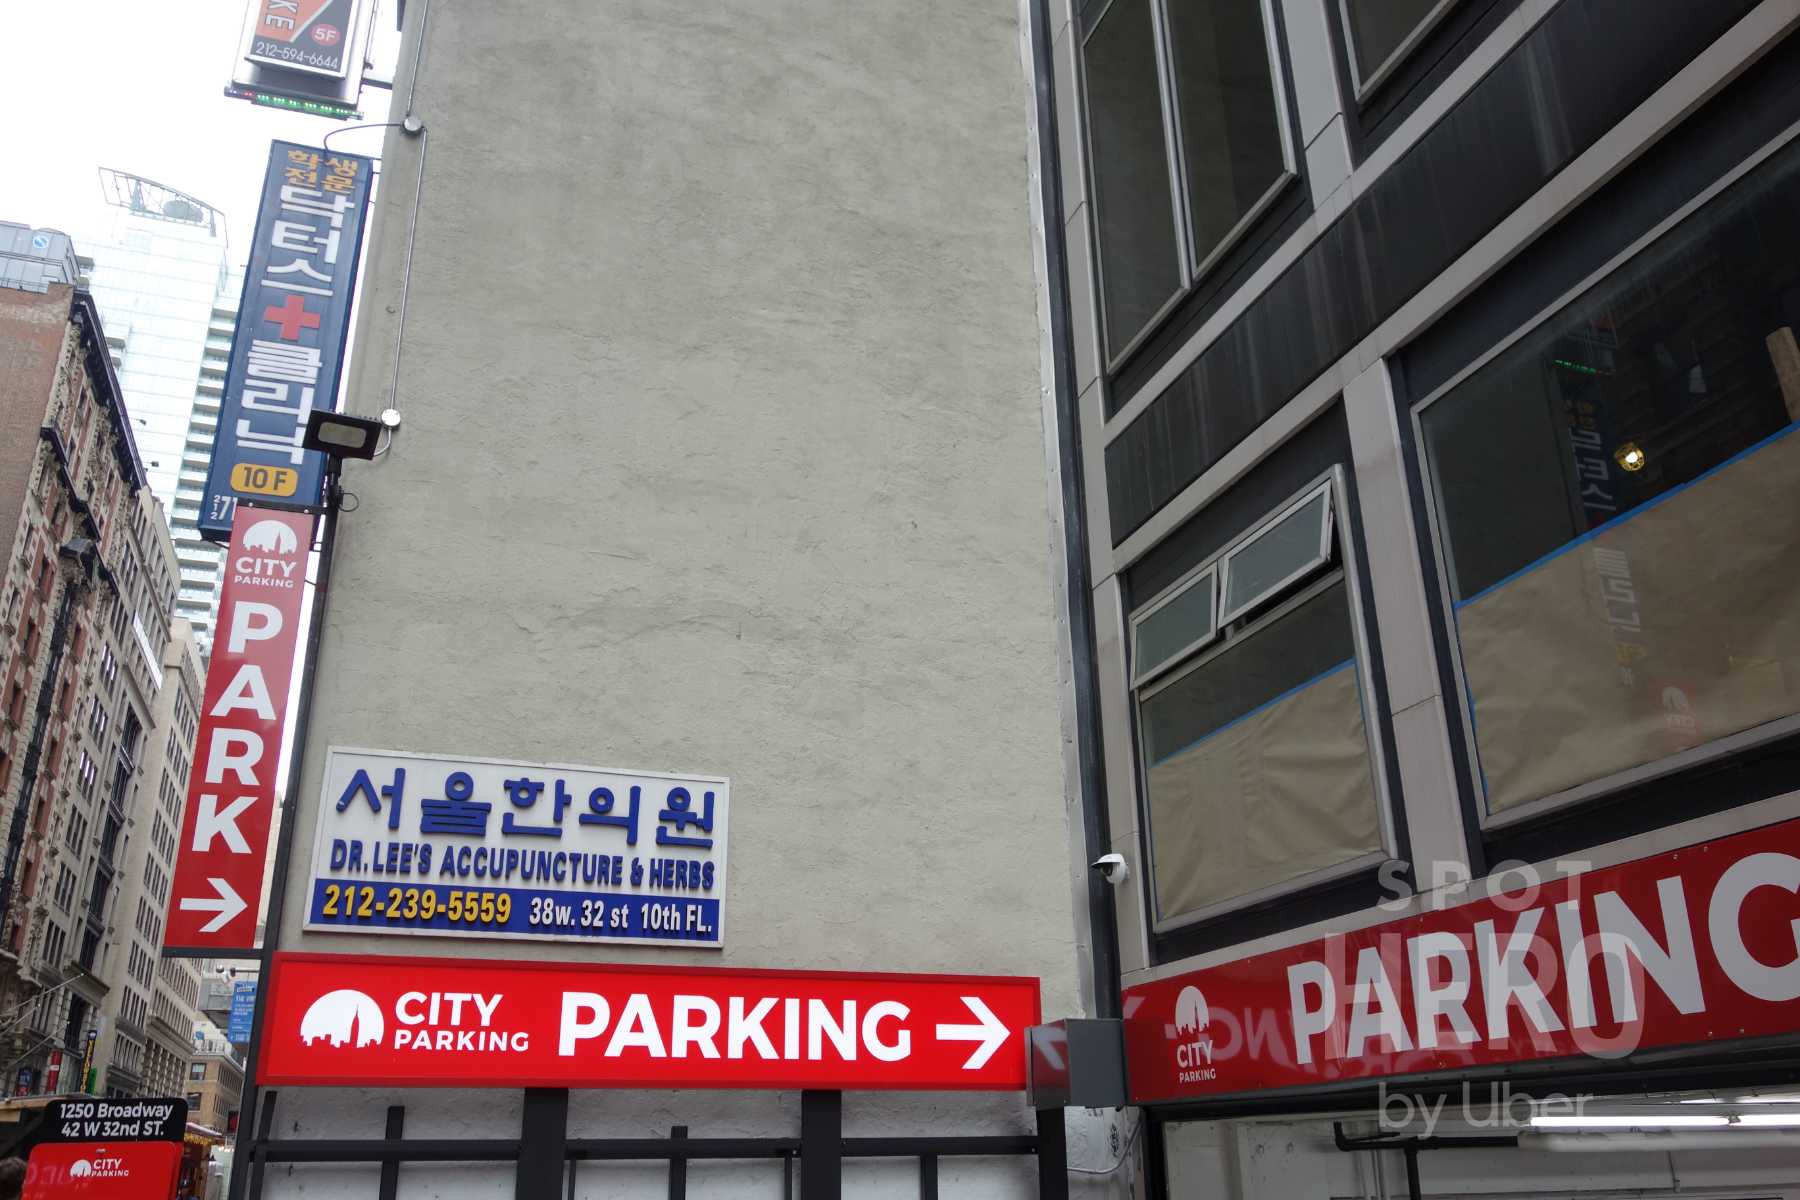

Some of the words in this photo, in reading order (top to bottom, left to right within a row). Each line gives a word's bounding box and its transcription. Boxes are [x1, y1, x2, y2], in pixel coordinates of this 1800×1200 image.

[314, 28, 337, 41] 5F
[256, 41, 339, 70] 212-594-6644
[260, 185, 356, 297] 닥터스
[235, 339, 323, 465] 클리닉
[235, 556, 297, 577] CITY
[234, 575, 295, 589] PARKING
[191, 600, 283, 855] PARK
[336, 767, 716, 850] 서울한의원
[439, 845, 624, 887] ACCUPUNCTURE
[629, 857, 645, 887] &
[649, 858, 715, 891] HERBS
[322, 884, 513, 923] 212-239-5559
[580, 899, 605, 928] 32
[610, 903, 630, 929] st
[641, 902, 682, 931] 10th
[686, 904, 712, 932] FL.
[1286, 852, 1800, 1065] PARKING
[395, 991, 504, 1027] CITY
[394, 1029, 529, 1052] PARKING
[558, 990, 913, 1062] PARKING
[1176, 1039, 1213, 1069] CITY
[1178, 1067, 1217, 1083] PARKING
[60, 1103, 94, 1119] 1250
[97, 1102, 174, 1121] Broadway
[61, 1121, 80, 1137] 42
[84, 1121, 101, 1137] W
[101, 1120, 140, 1137] 32nd
[142, 1121, 164, 1136] ST.
[92, 1168, 129, 1177] PARKING
[93, 1158, 122, 1170] CITY
